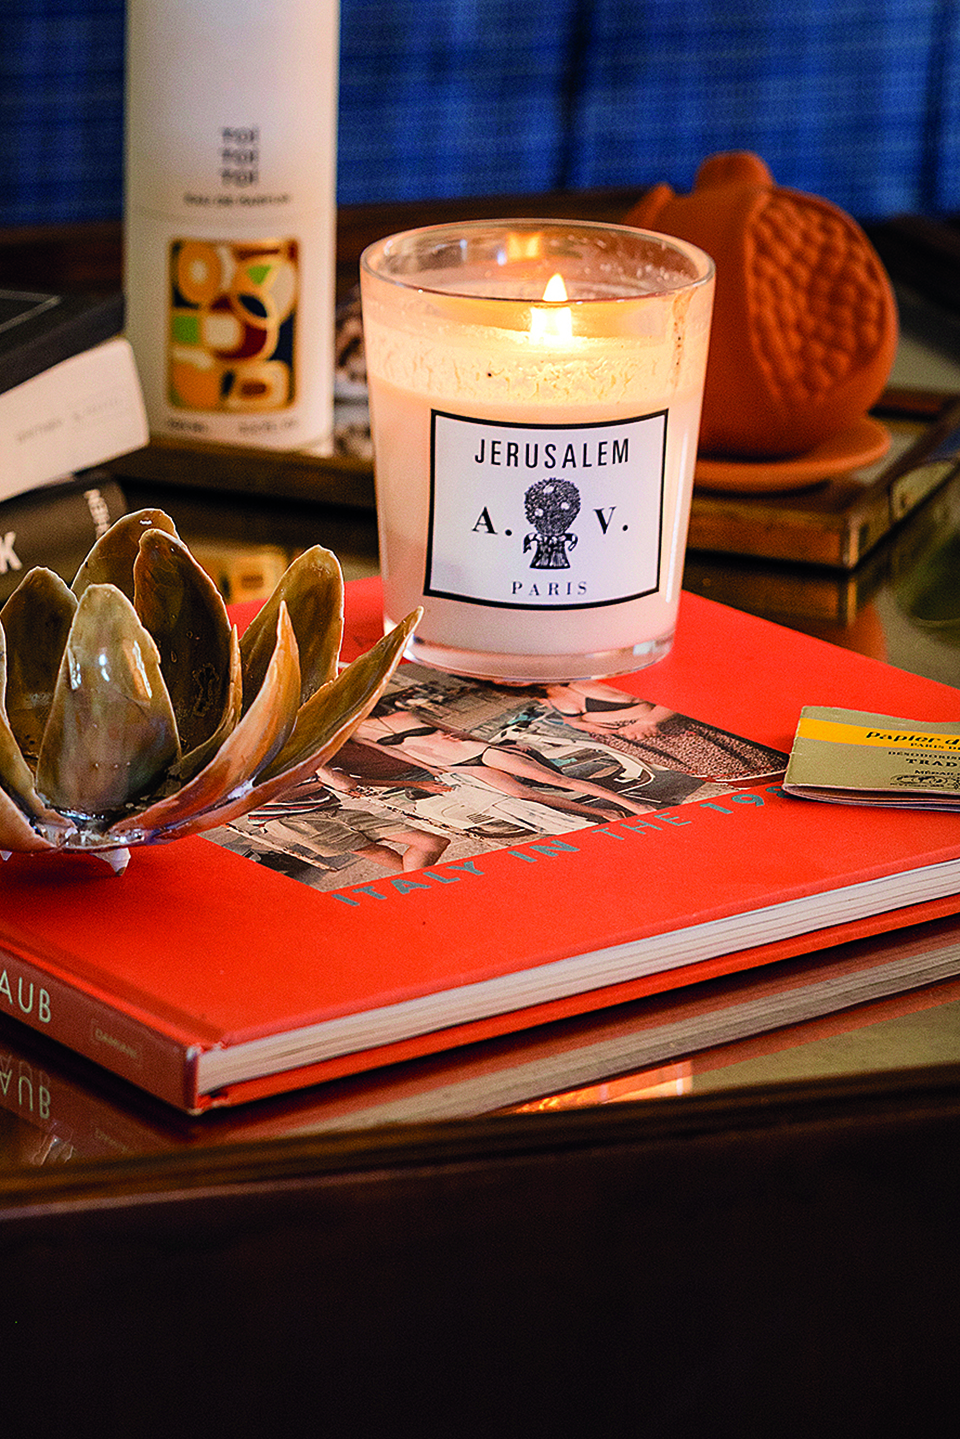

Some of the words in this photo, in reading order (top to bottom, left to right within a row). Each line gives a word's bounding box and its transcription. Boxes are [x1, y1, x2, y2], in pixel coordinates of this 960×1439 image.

[474, 437, 630, 469] JERUSALEM
[471, 506, 513, 537] A.
[593, 505, 630, 535] V.
[511, 580, 588, 597] PARIS
[331, 860, 485, 907] ITALY
[507, 839, 581, 863] IN
[591, 811, 693, 841] THE
